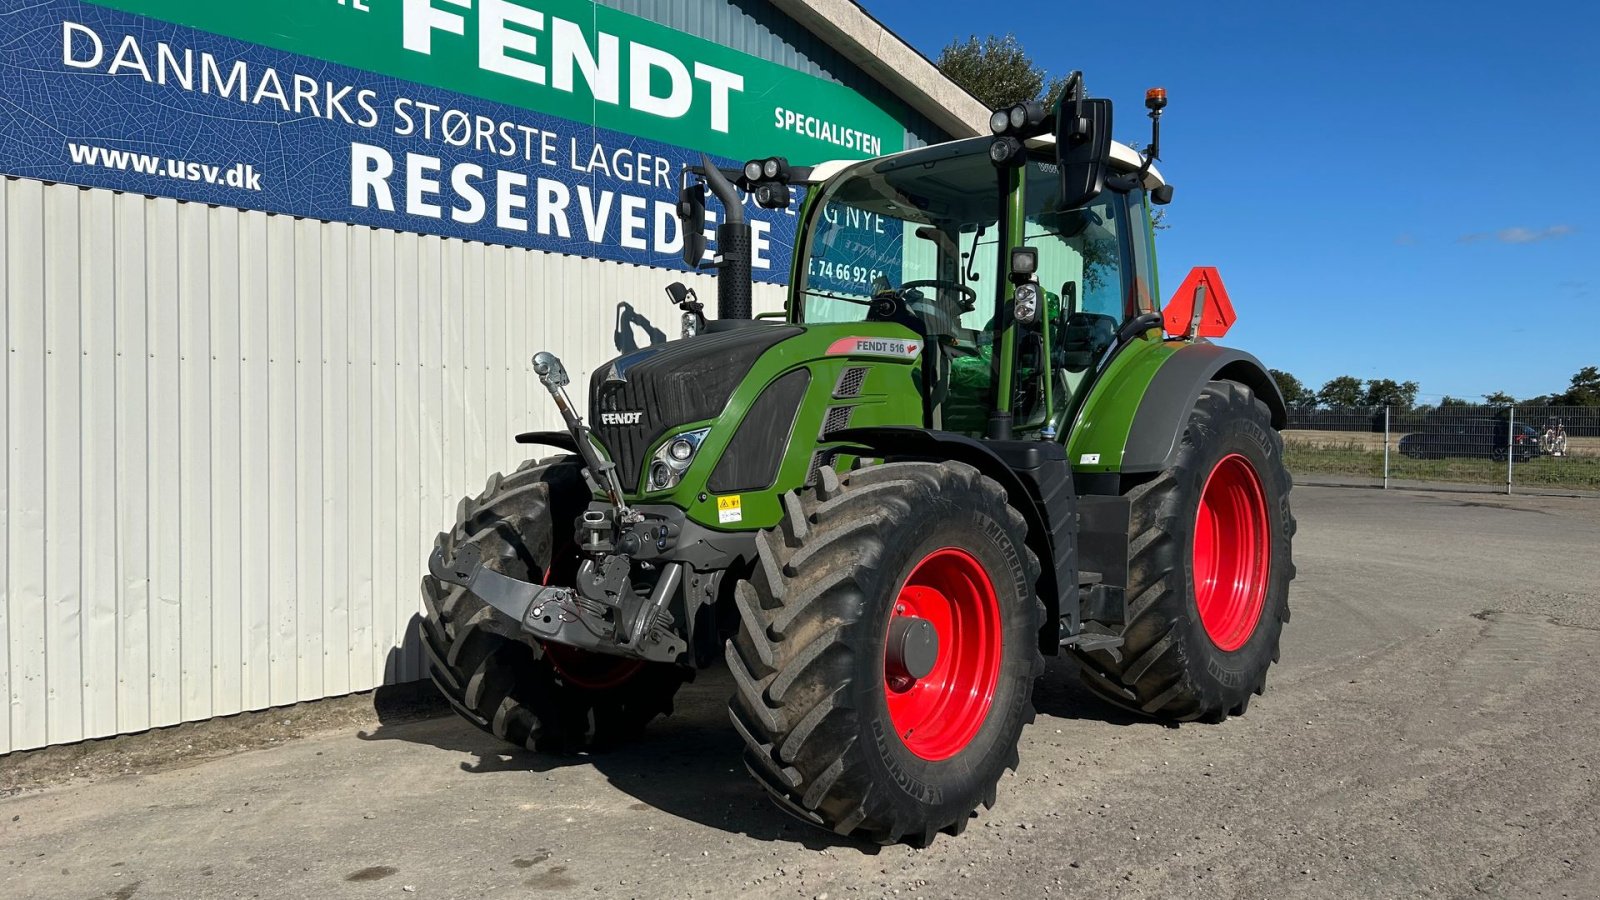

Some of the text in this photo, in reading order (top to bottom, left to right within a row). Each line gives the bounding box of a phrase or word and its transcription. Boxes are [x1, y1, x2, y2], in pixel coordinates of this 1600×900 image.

[403, 0, 744, 134] FENDT
[63, 21, 379, 128] DANMARKS
[394, 97, 557, 164] STØRSTE
[570, 137, 670, 189] LAGER
[846, 206, 885, 233] NYE
[774, 107, 881, 156] SPECIALISTEN
[68, 142, 262, 191] www.usv.dk
[351, 142, 771, 270] RESERVEDEE
[820, 261, 833, 278] 74
[836, 263, 850, 280] 66
[853, 266, 867, 283] 92
[857, 340, 905, 353] FENDT 516
[602, 412, 642, 425] FENDT
[985, 520, 1028, 599] MICHELIN
[871, 718, 926, 801] MICHELIN
